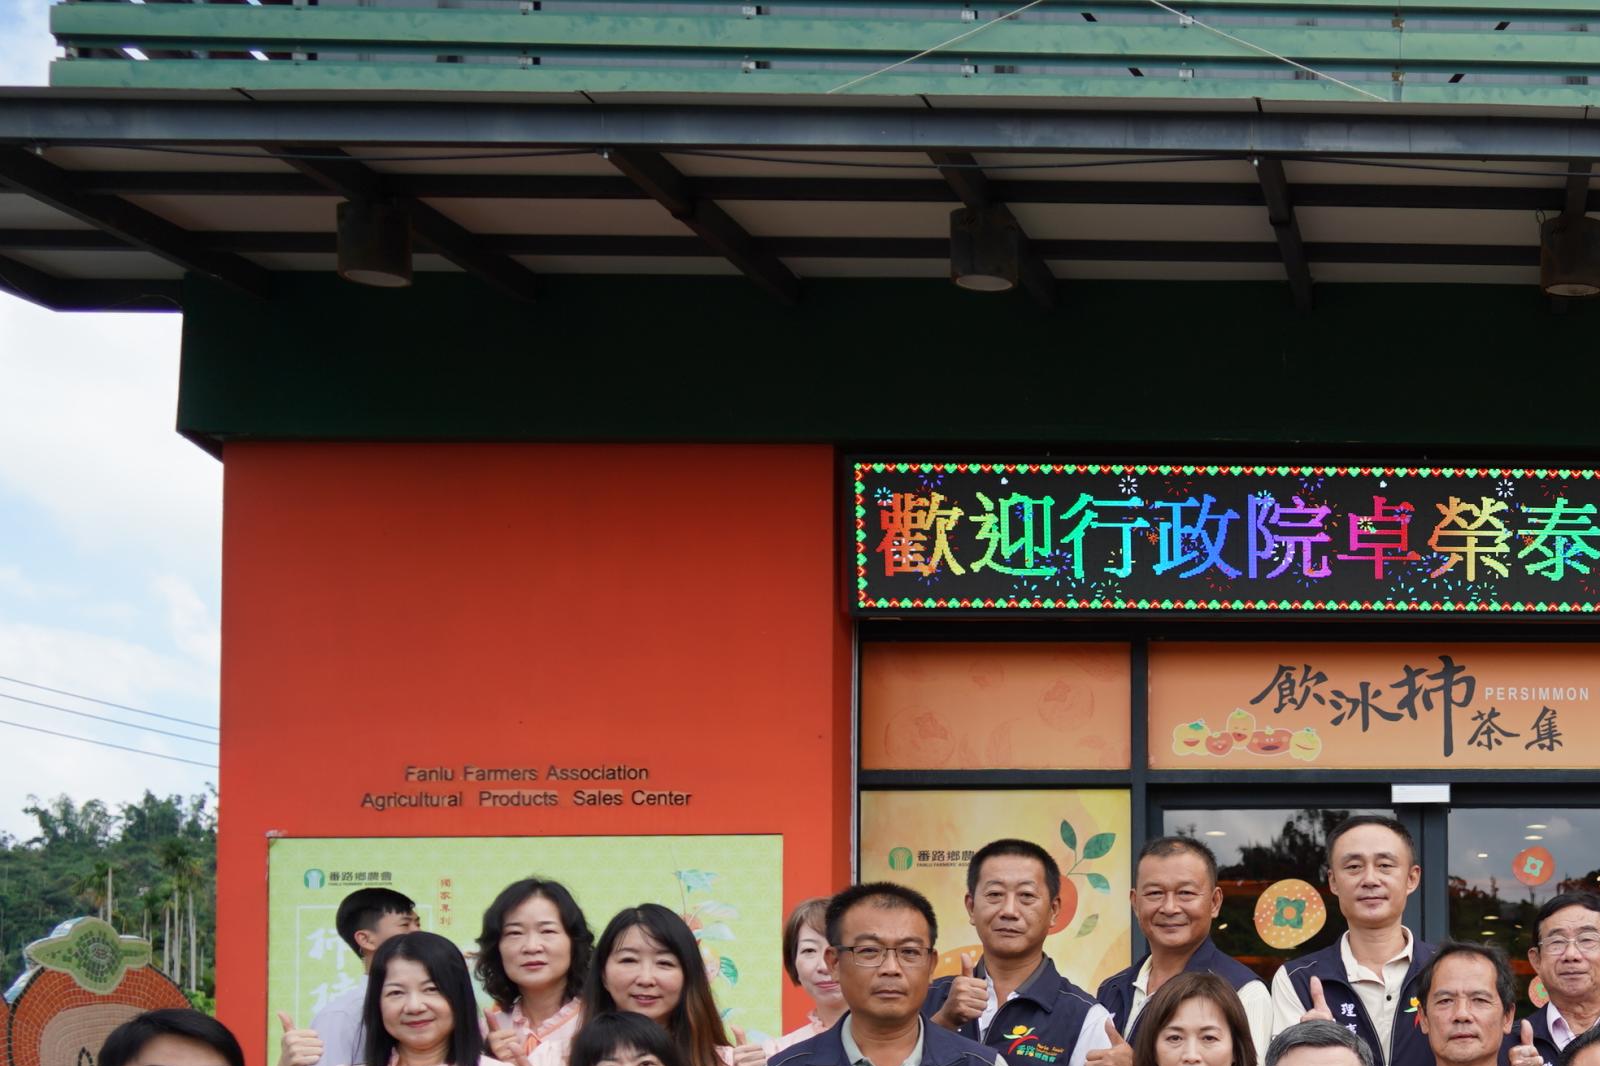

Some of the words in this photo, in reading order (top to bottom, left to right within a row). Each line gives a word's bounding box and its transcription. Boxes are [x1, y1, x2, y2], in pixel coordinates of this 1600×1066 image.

[1484, 687, 1589, 700] PERSIMMON
[1467, 706, 1564, 751] 茶集
[405, 766, 455, 781] Fanlu
[463, 766, 538, 781] Farmers
[546, 765, 649, 781] Association
[361, 792, 463, 811] Agricultural
[479, 791, 559, 807] Products
[573, 790, 623, 806] Sales
[631, 790, 693, 806] Center
